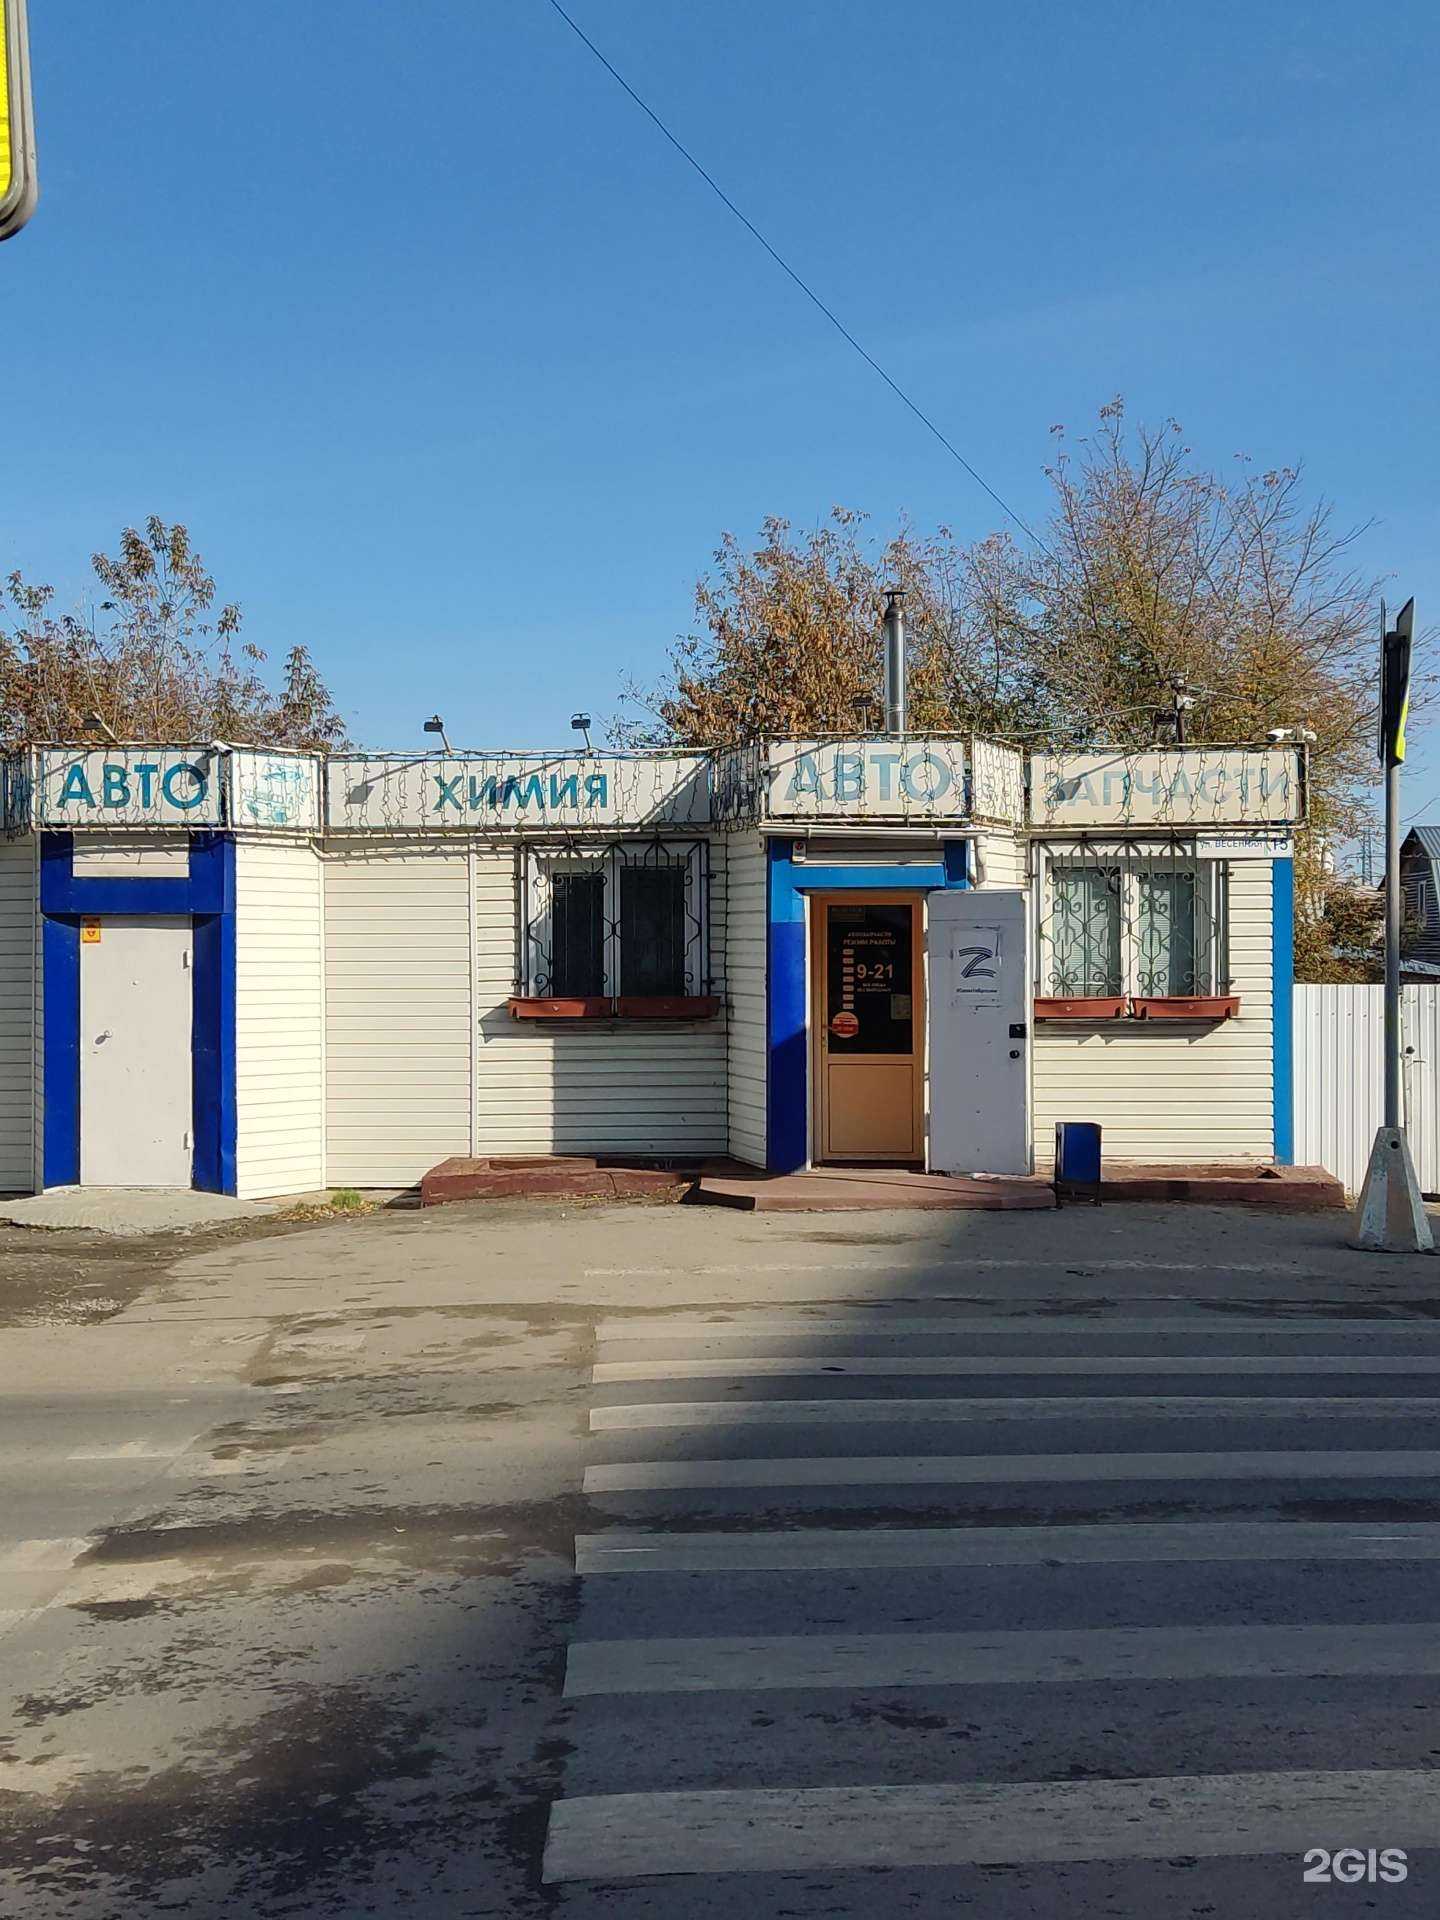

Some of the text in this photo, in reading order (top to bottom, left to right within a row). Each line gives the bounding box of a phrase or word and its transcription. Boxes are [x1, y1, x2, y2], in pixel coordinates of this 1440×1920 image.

[56, 762, 208, 809] АВТО
[431, 773, 608, 810] ХИМИЯ
[783, 752, 951, 801] АВТО
[856, 964, 894, 979] 9-21
